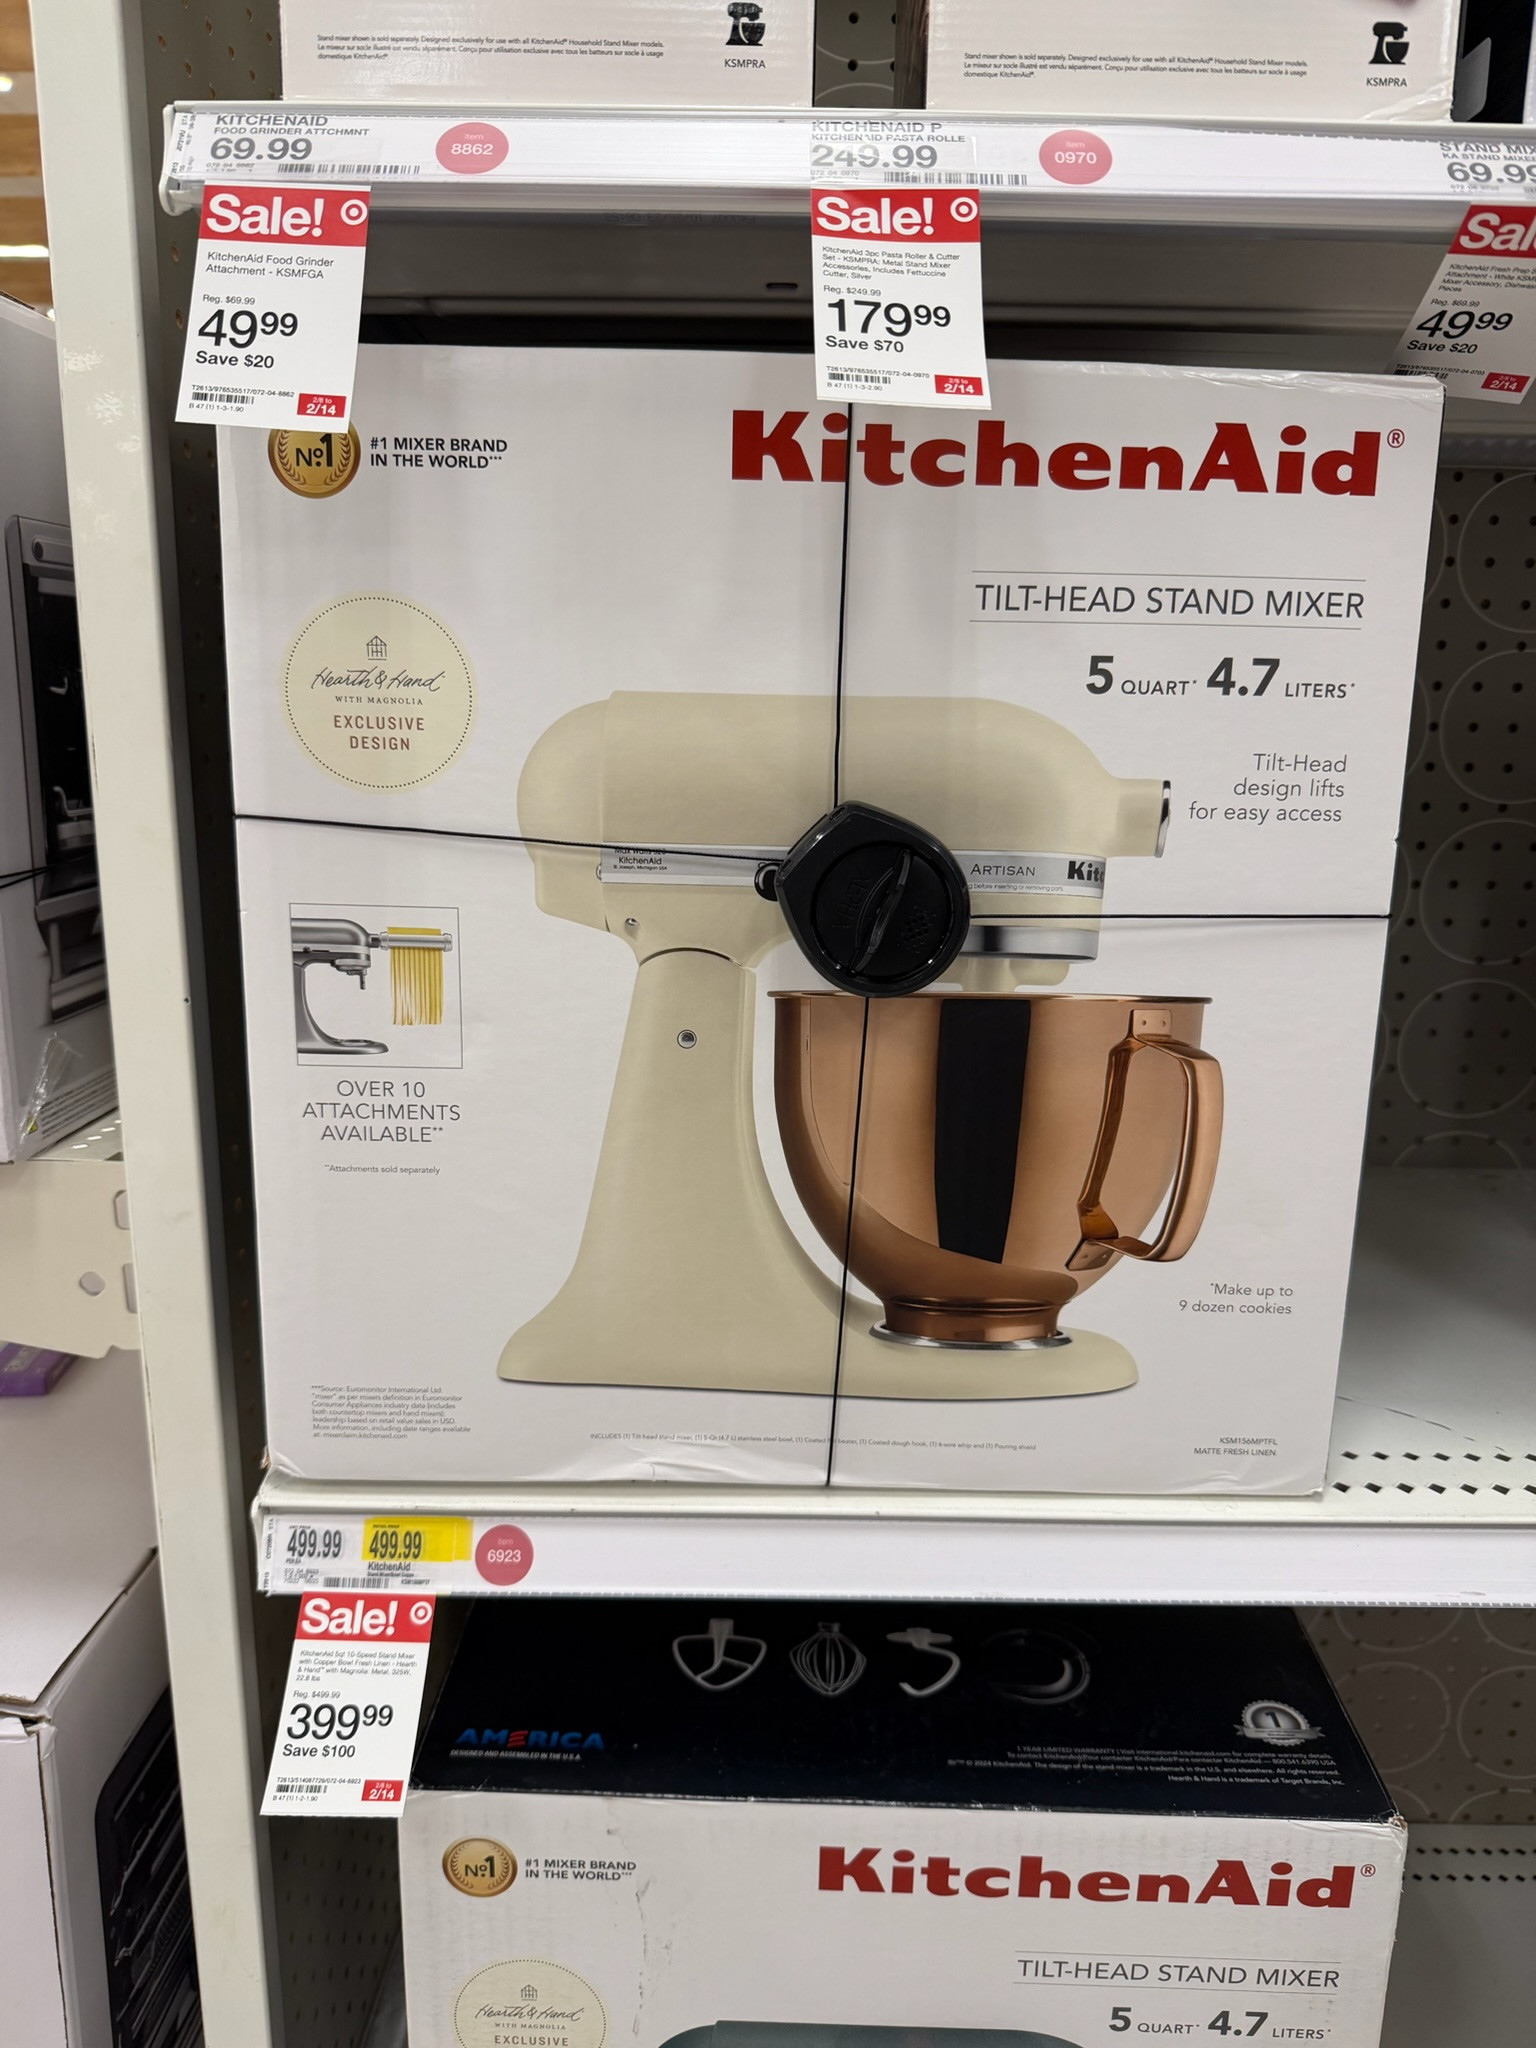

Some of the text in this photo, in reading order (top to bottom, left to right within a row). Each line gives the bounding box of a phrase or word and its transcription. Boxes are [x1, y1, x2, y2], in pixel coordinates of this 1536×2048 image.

[724, 59, 766, 69] KSMPRA
[1366, 77, 1407, 87] KSMPRA
[216, 115, 328, 126] KITCHENAID
[812, 121, 942, 133] KITCHENAID P
[214, 127, 247, 135] FOOD
[305, 128, 370, 136] ATTCHMNT
[812, 134, 883, 142] KITCHENAID
[886, 134, 924, 142] PASTA
[210, 137, 312, 160] 69.99
[451, 143, 494, 156] 8862
[812, 145, 938, 168] 249.99
[1054, 152, 1097, 164] 0970
[1462, 153, 1501, 161] STAND
[206, 192, 325, 238] Sale!
[816, 196, 934, 236] Sale!
[1459, 212, 1536, 250] Sal
[208, 252, 334, 266] KitchenAid Food Grinder
[822, 246, 864, 256] KitchenAid
[865, 250, 879, 258] 3pc
[882, 251, 902, 259] Pasta
[843, 256, 880, 265] KSMPRA:
[206, 264, 324, 278] Attachment KSMFGA
[823, 262, 946, 277] Accessories, Includes Fettuccine
[823, 270, 872, 280] Cutter, Silver
[823, 285, 881, 296] Reg. $249.99
[202, 294, 256, 305] Reg. $69.99
[1430, 298, 1480, 308] Reg. $69.99
[825, 336, 904, 353] Save $70
[1407, 340, 1478, 354] Save $20
[196, 350, 274, 368] Save $20
[944, 384, 974, 394] 2/14
[1490, 380, 1517, 391] 2/14
[306, 404, 336, 415] 2/14
[370, 437, 508, 452] #1 MIXER BRAND
[370, 454, 387, 467] IN
[392, 454, 423, 468] THE
[975, 584, 1364, 619] TILT-HEAD STAND MIXER
[311, 666, 378, 689] Hearth
[375, 670, 387, 690] &
[1086, 655, 1114, 695] 5
[1206, 656, 1280, 696] 4.7
[367, 697, 423, 705] MAGNOLIA
[333, 715, 425, 731] EXCLUSIVE
[350, 736, 410, 750] DESIGN
[1253, 753, 1348, 773] Tilt-Head
[1233, 778, 1344, 801] design lifts
[1188, 801, 1342, 825] for easy access
[618, 857, 662, 865] KitchenAid
[970, 863, 1036, 877] ARTISAN
[336, 1080, 425, 1098] OVER 10
[302, 1102, 461, 1121] ATTACHMENTS
[400, 1166, 440, 1175] separately
[1256, 1287, 1274, 1299] up
[1279, 1286, 1293, 1296] to
[1179, 1300, 1292, 1314] 9 dozen cookies
[287, 1528, 422, 1559] 499.99 499.99
[487, 1549, 522, 1563] 6923
[368, 1562, 411, 1572] KitchenAid
[301, 1598, 398, 1636] Sale!
[300, 1650, 334, 1658] KitchenAid
[347, 1651, 377, 1659] 10-Speed
[293, 1690, 341, 1699] Reg. $499.99
[456, 1728, 604, 1750] AMERICA
[283, 1744, 356, 1758] Save $100
[369, 1788, 394, 1800] 2/14
[525, 1859, 636, 1870] #1 MIXER BRAND
[525, 1870, 539, 1878] IN
[544, 1870, 568, 1879] THE
[1017, 1959, 1339, 1989] TILT-HEAD STAND MIXER
[474, 2004, 529, 2019] Hearth
[527, 2005, 537, 2019] &
[1108, 2007, 1132, 2032] 5
[1207, 2010, 1268, 2037] 4.7
[494, 2035, 569, 2046] EXCLUSIVE
